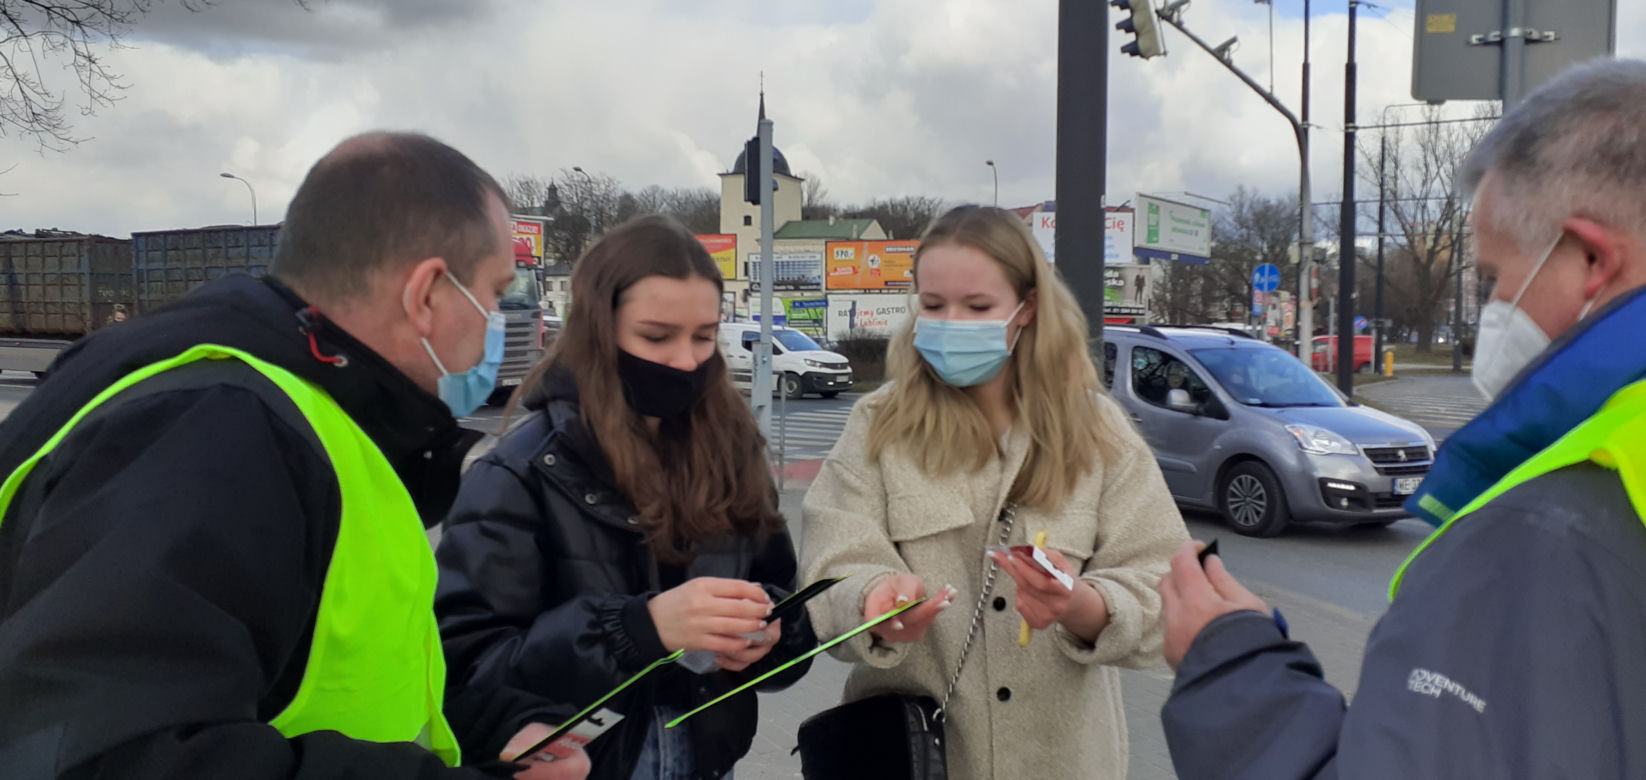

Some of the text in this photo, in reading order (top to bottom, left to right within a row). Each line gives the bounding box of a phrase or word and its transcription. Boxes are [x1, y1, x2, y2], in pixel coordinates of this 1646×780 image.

[1104, 216, 1125, 232] Cię
[876, 306, 906, 315] GASTRO
[1408, 680, 1442, 698] TECH
